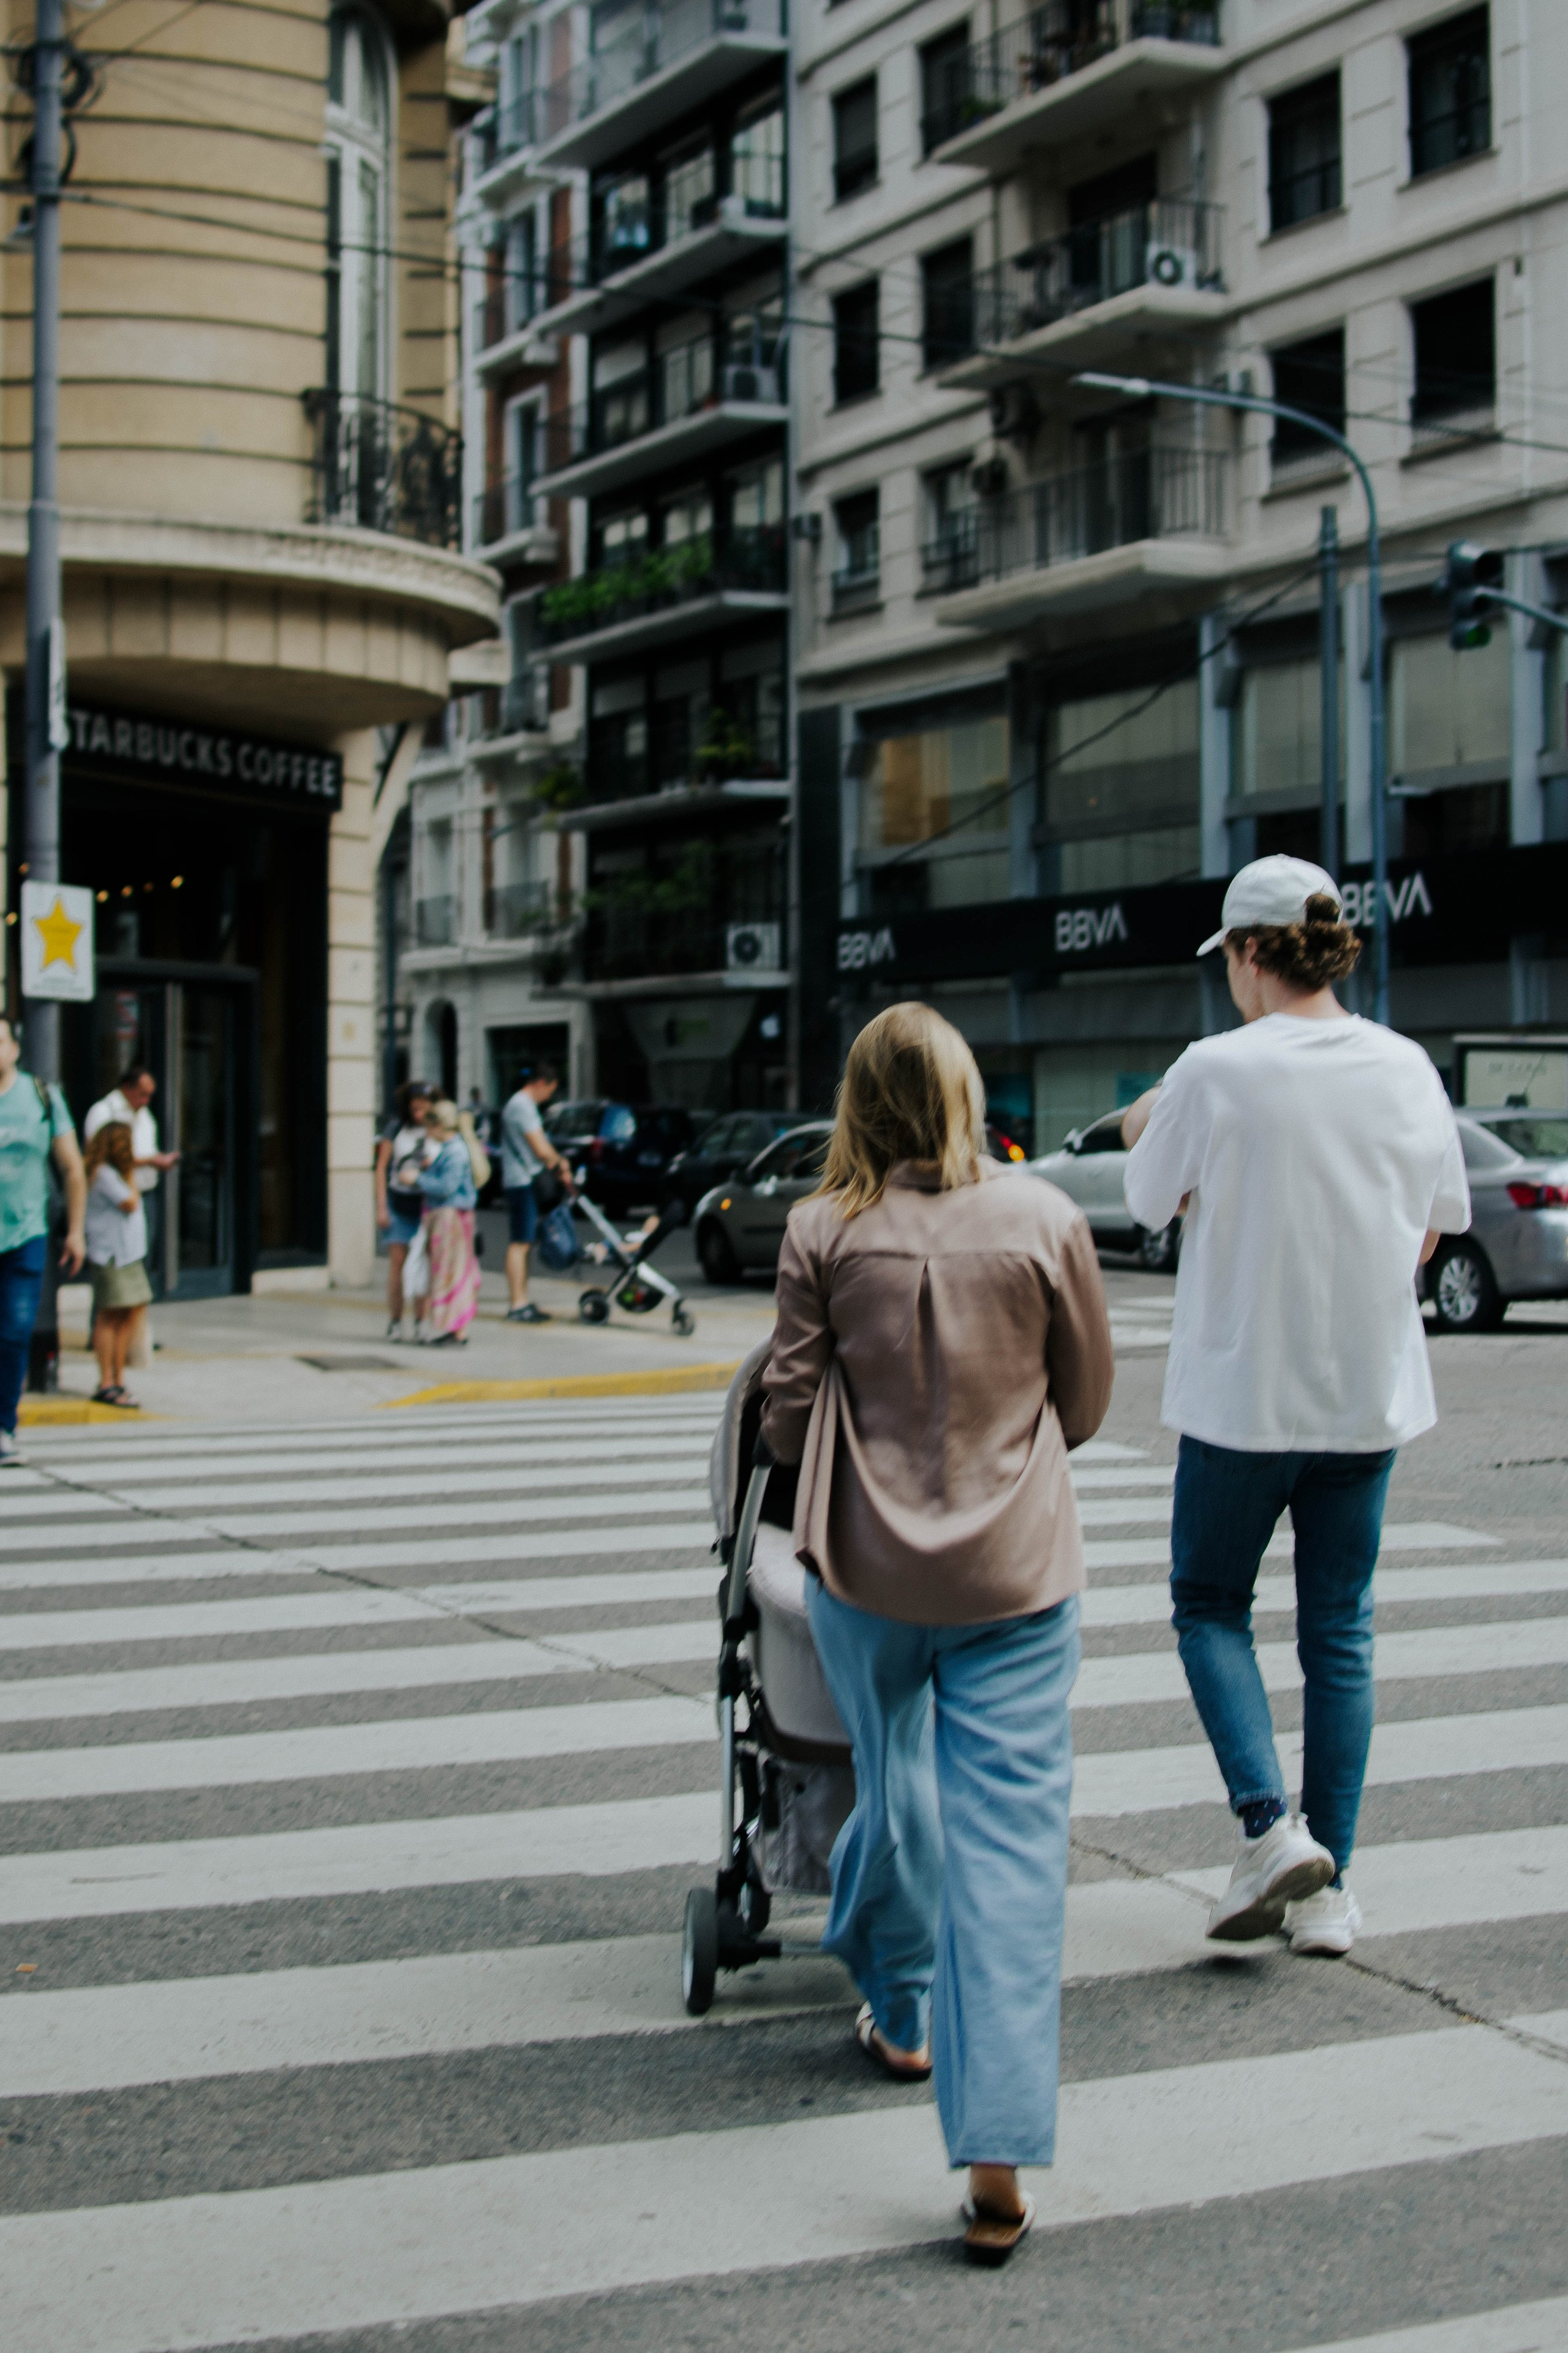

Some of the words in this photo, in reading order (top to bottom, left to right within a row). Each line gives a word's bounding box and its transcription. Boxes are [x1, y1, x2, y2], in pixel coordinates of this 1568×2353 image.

[70, 709, 233, 777] TARBUCKS
[236, 741, 336, 796] COFFEE
[1341, 872, 1433, 926] BBVA
[837, 925, 897, 970] BBVA
[1054, 901, 1128, 952] BBVA
